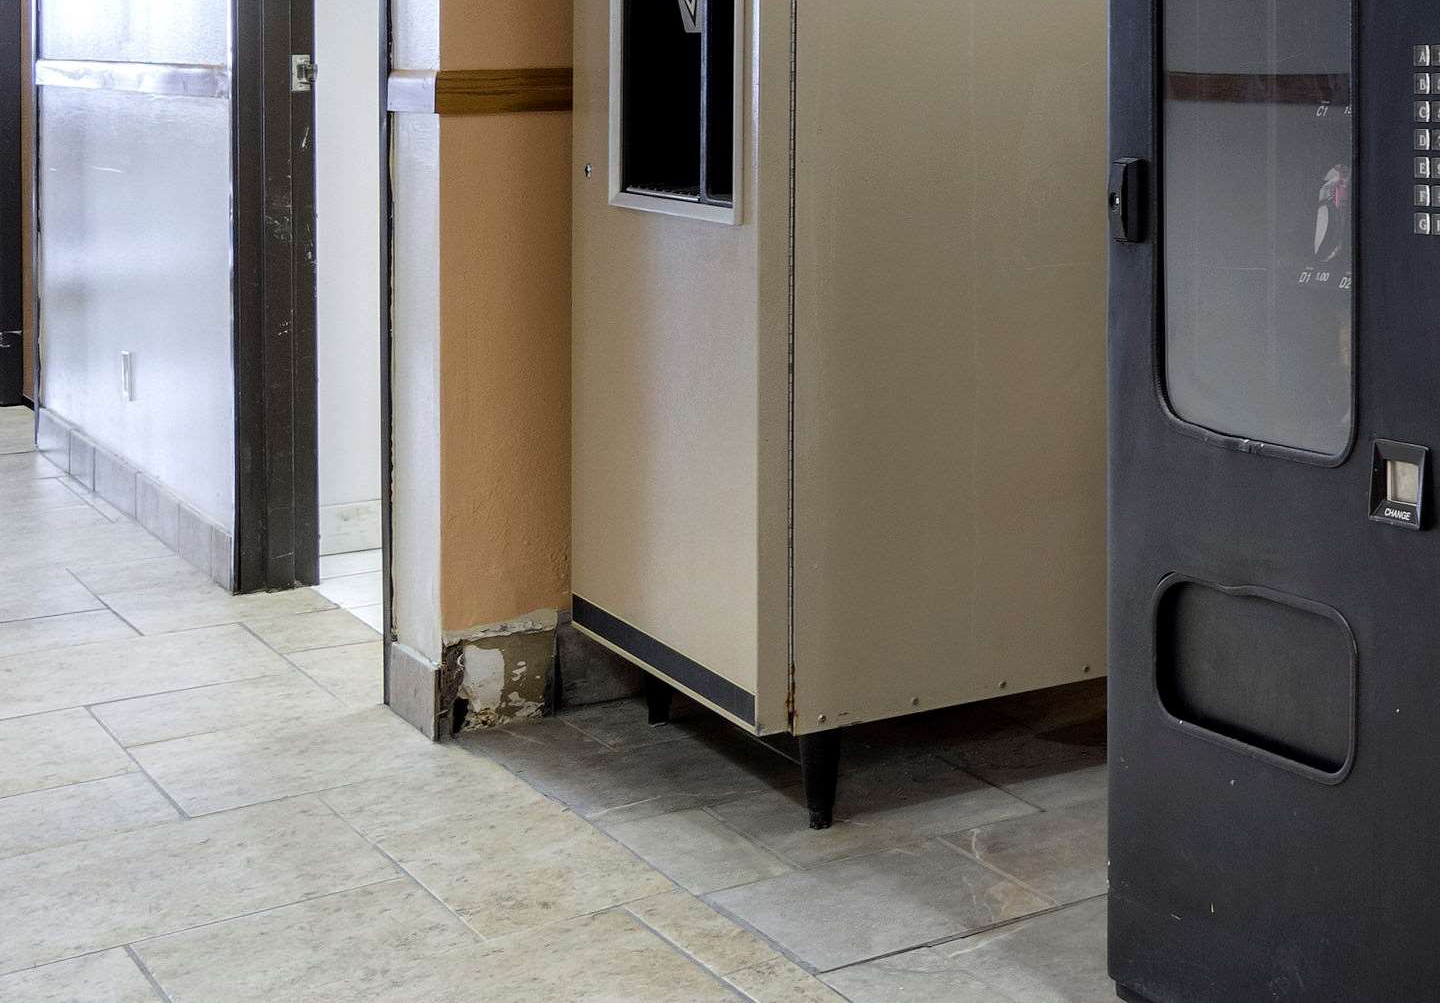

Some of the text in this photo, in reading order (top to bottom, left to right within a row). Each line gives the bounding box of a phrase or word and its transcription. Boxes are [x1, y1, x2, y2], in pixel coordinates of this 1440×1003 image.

[1419, 51, 1426, 62] A
[1419, 79, 1426, 90] B
[1419, 107, 1426, 119] C
[1419, 135, 1426, 147] D
[1419, 163, 1426, 174] E
[1419, 219, 1427, 230] G
[1298, 271, 1311, 283] D1
[1384, 507, 1412, 521] CHANGE
